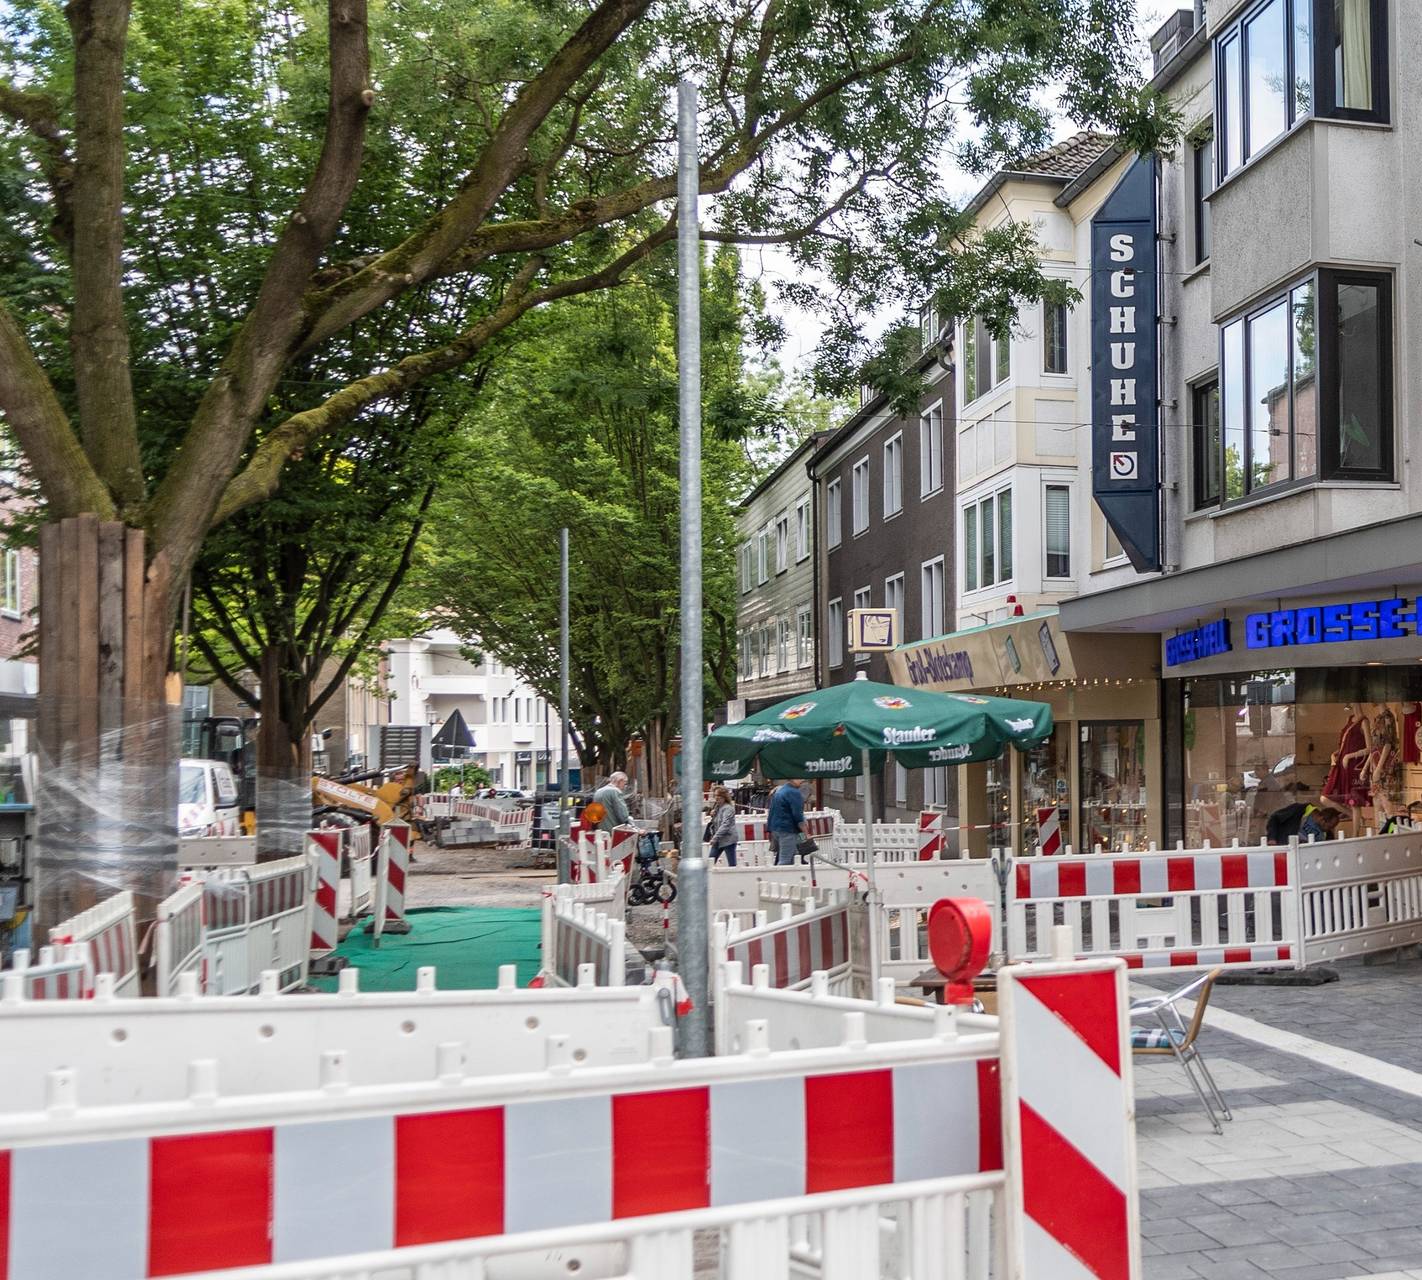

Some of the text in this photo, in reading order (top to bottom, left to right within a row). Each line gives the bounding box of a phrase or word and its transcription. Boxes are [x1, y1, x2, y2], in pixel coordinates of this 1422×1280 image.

[1109, 233, 1137, 442] SCHUHE
[883, 726, 936, 745] Stauder
[319, 779, 377, 804] STOLTE
